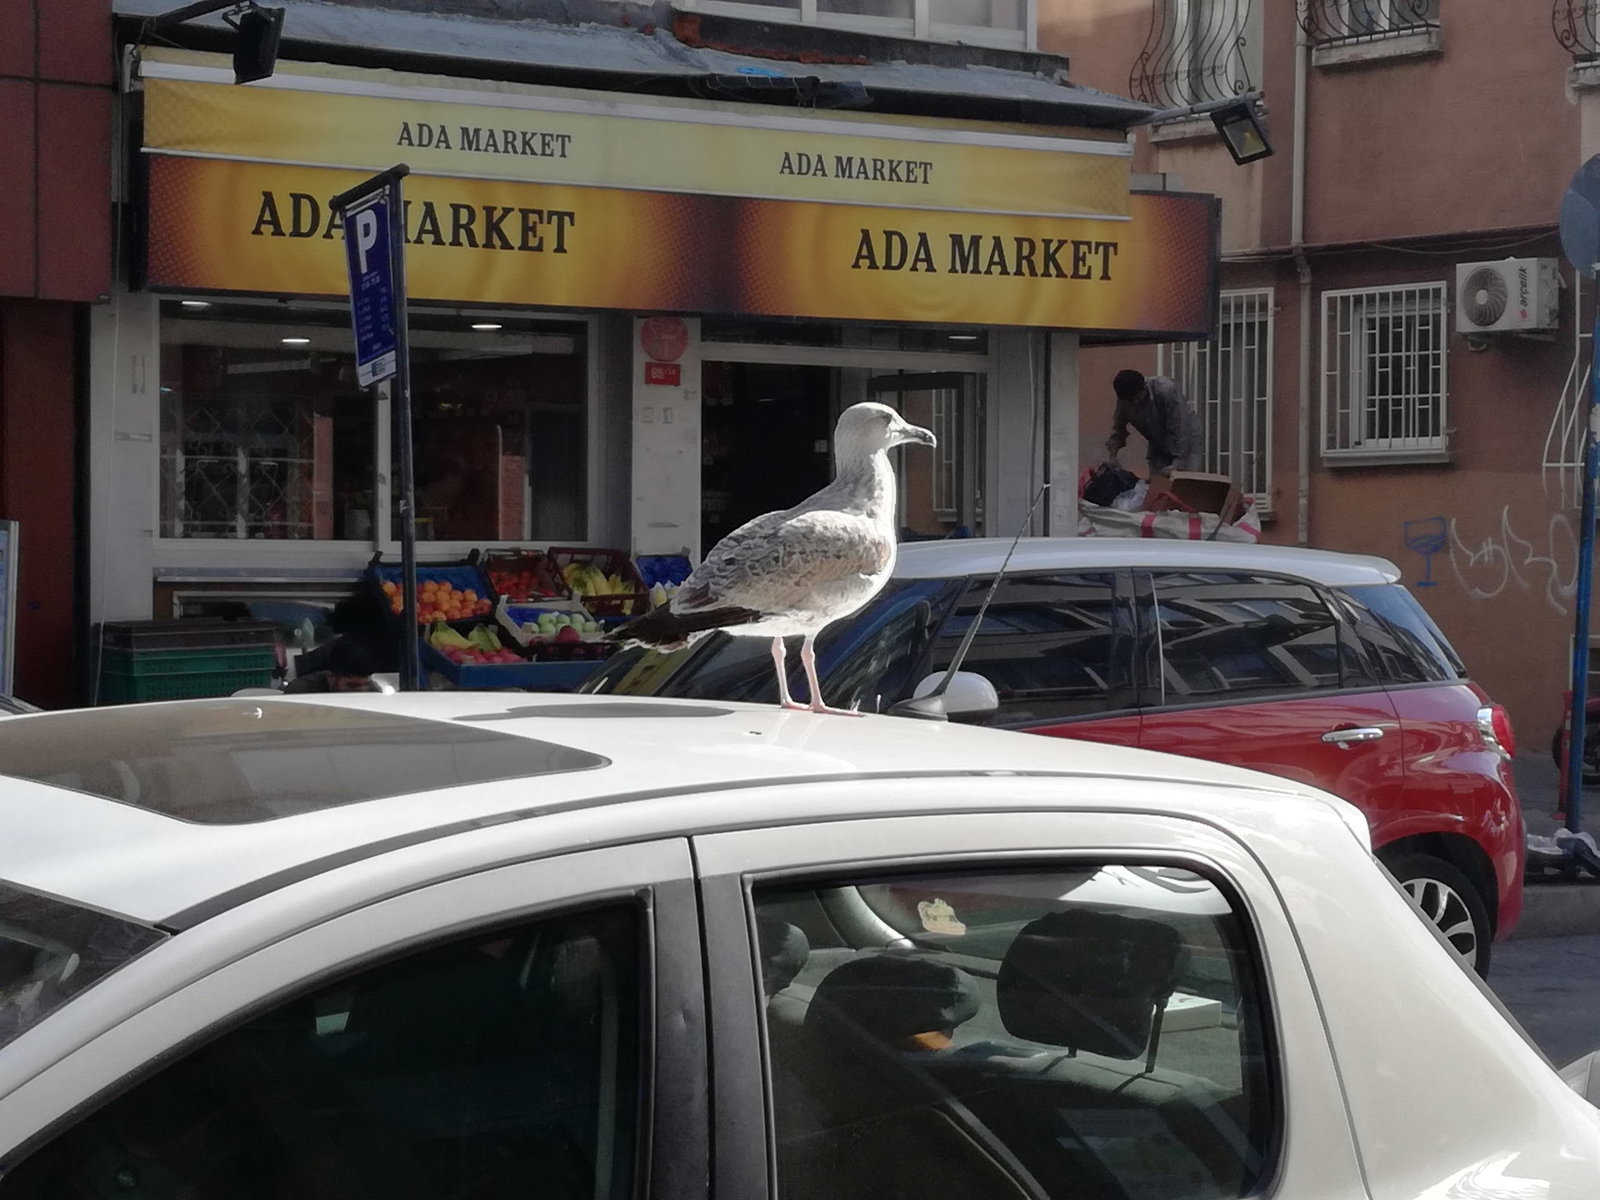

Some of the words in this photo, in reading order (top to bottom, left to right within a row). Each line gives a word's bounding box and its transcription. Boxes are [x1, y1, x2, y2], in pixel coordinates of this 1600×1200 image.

[397, 121, 452, 149] ADA
[459, 126, 571, 158] MARKET
[780, 151, 828, 177] ADA
[834, 155, 933, 184] MARKET
[356, 209, 378, 274] P
[851, 228, 937, 272] ADA
[948, 233, 1118, 281] MARKET
